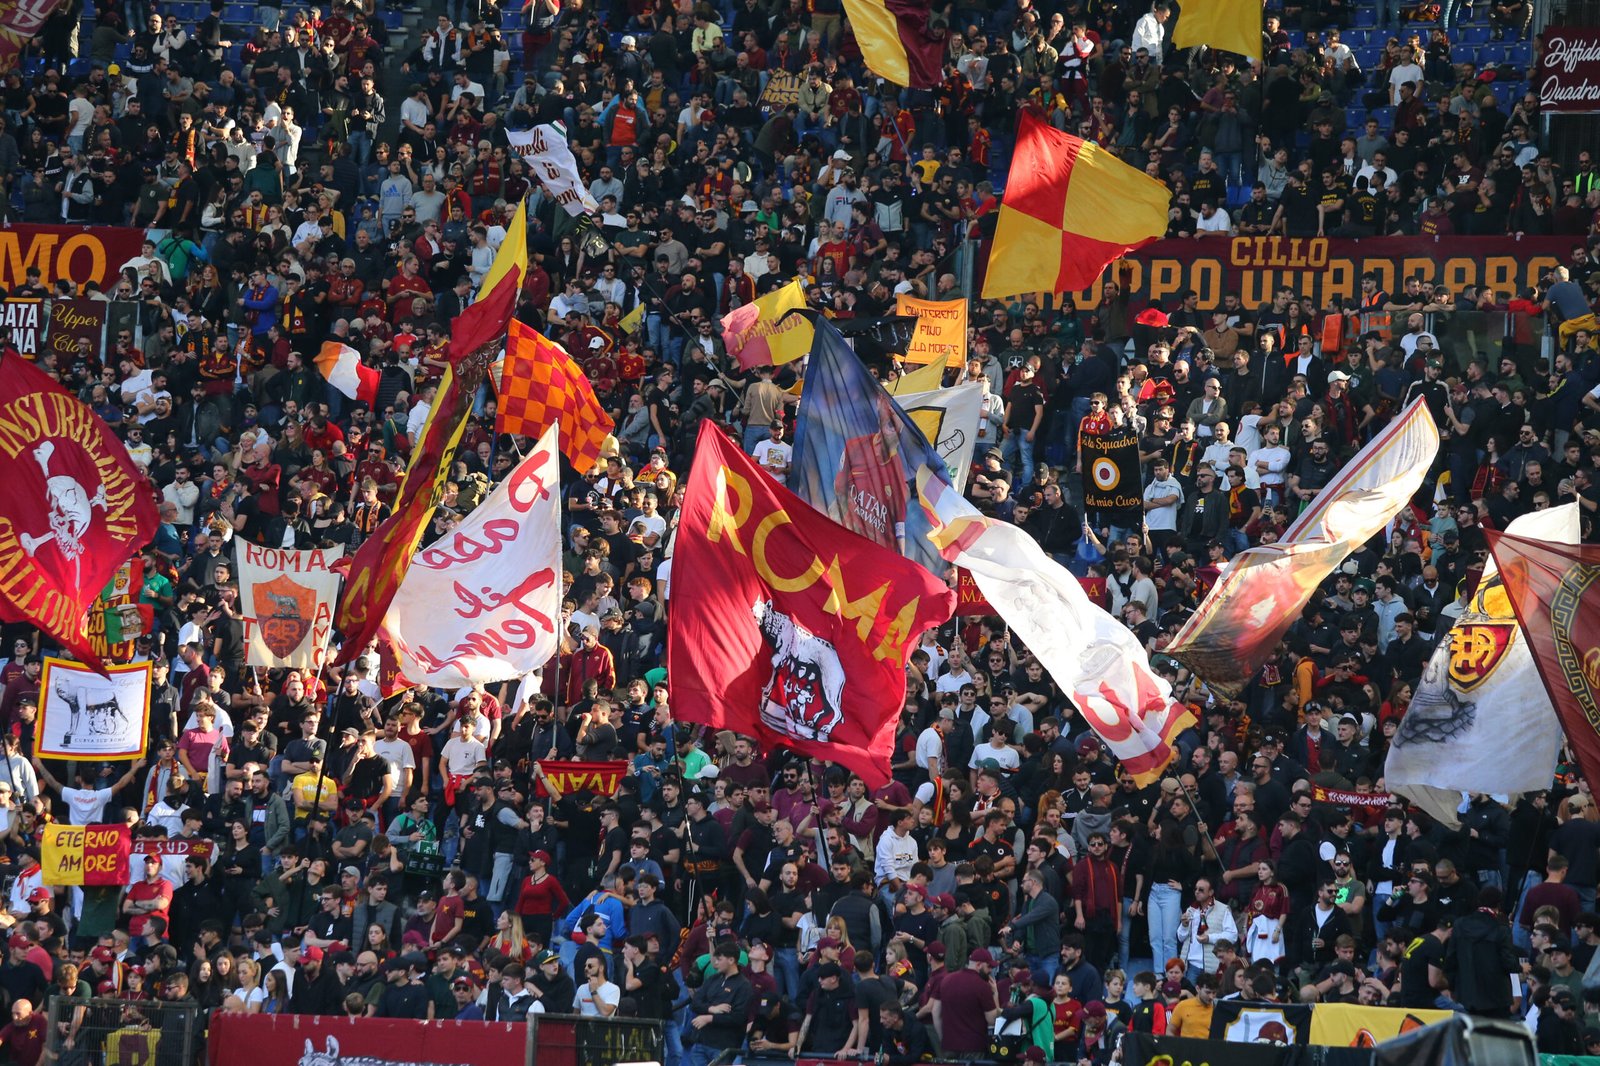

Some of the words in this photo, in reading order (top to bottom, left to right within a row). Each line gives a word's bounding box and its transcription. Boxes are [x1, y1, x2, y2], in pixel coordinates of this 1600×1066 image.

[1230, 236, 1329, 268] CILLO
[51, 303, 99, 330] Upper
[850, 484, 888, 524] QATAR
[246, 543, 327, 572] ROMA
[706, 465, 921, 669] ROMA
[547, 772, 617, 794] IVAN
[56, 831, 120, 848] ETERNO
[157, 842, 189, 853] SUD
[58, 853, 117, 873] AMORE
